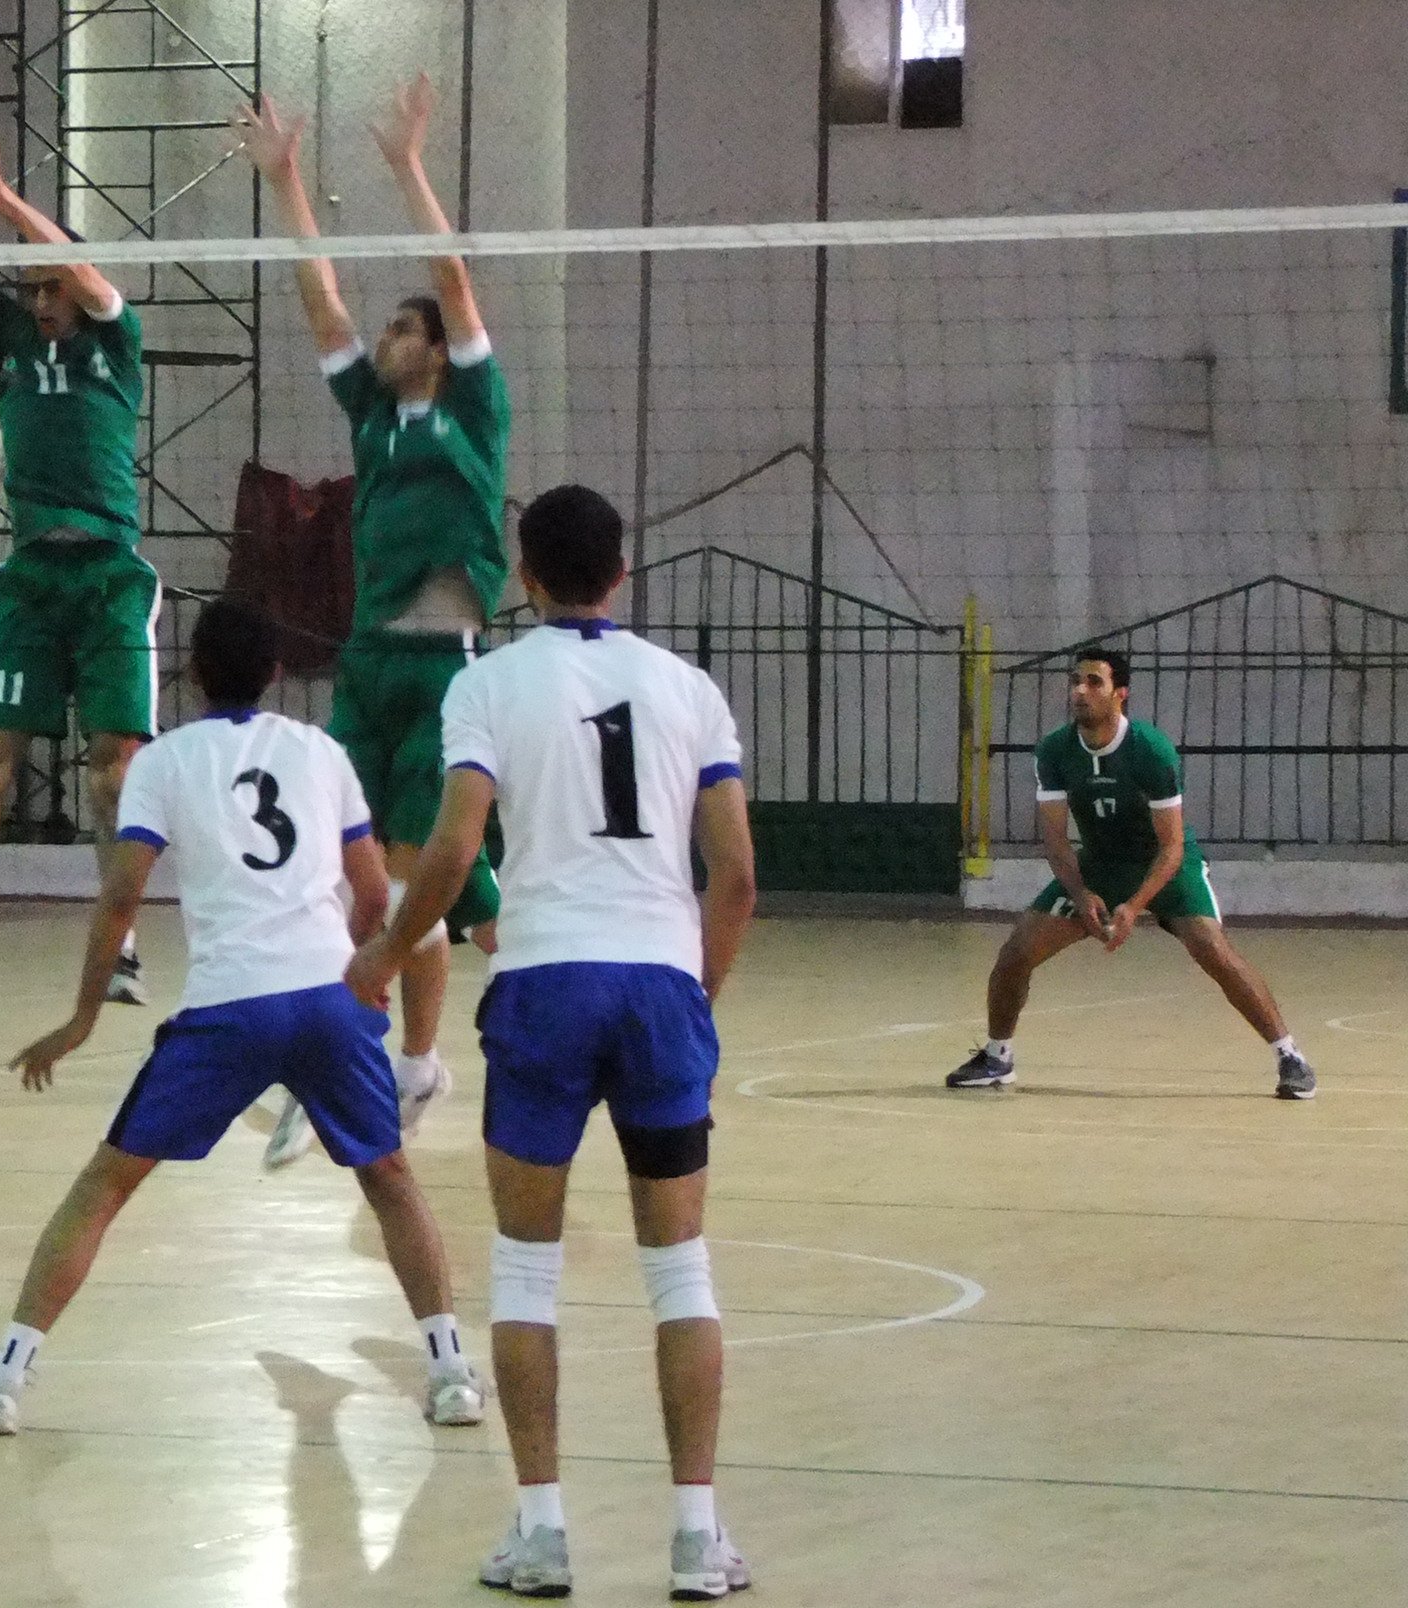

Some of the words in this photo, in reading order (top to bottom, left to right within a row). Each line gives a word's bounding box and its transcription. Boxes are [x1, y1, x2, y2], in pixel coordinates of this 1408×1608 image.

[33, 359, 69, 395] 11
[580, 699, 655, 839] 1
[230, 766, 298, 871] 3
[1093, 797, 1117, 819] 17
